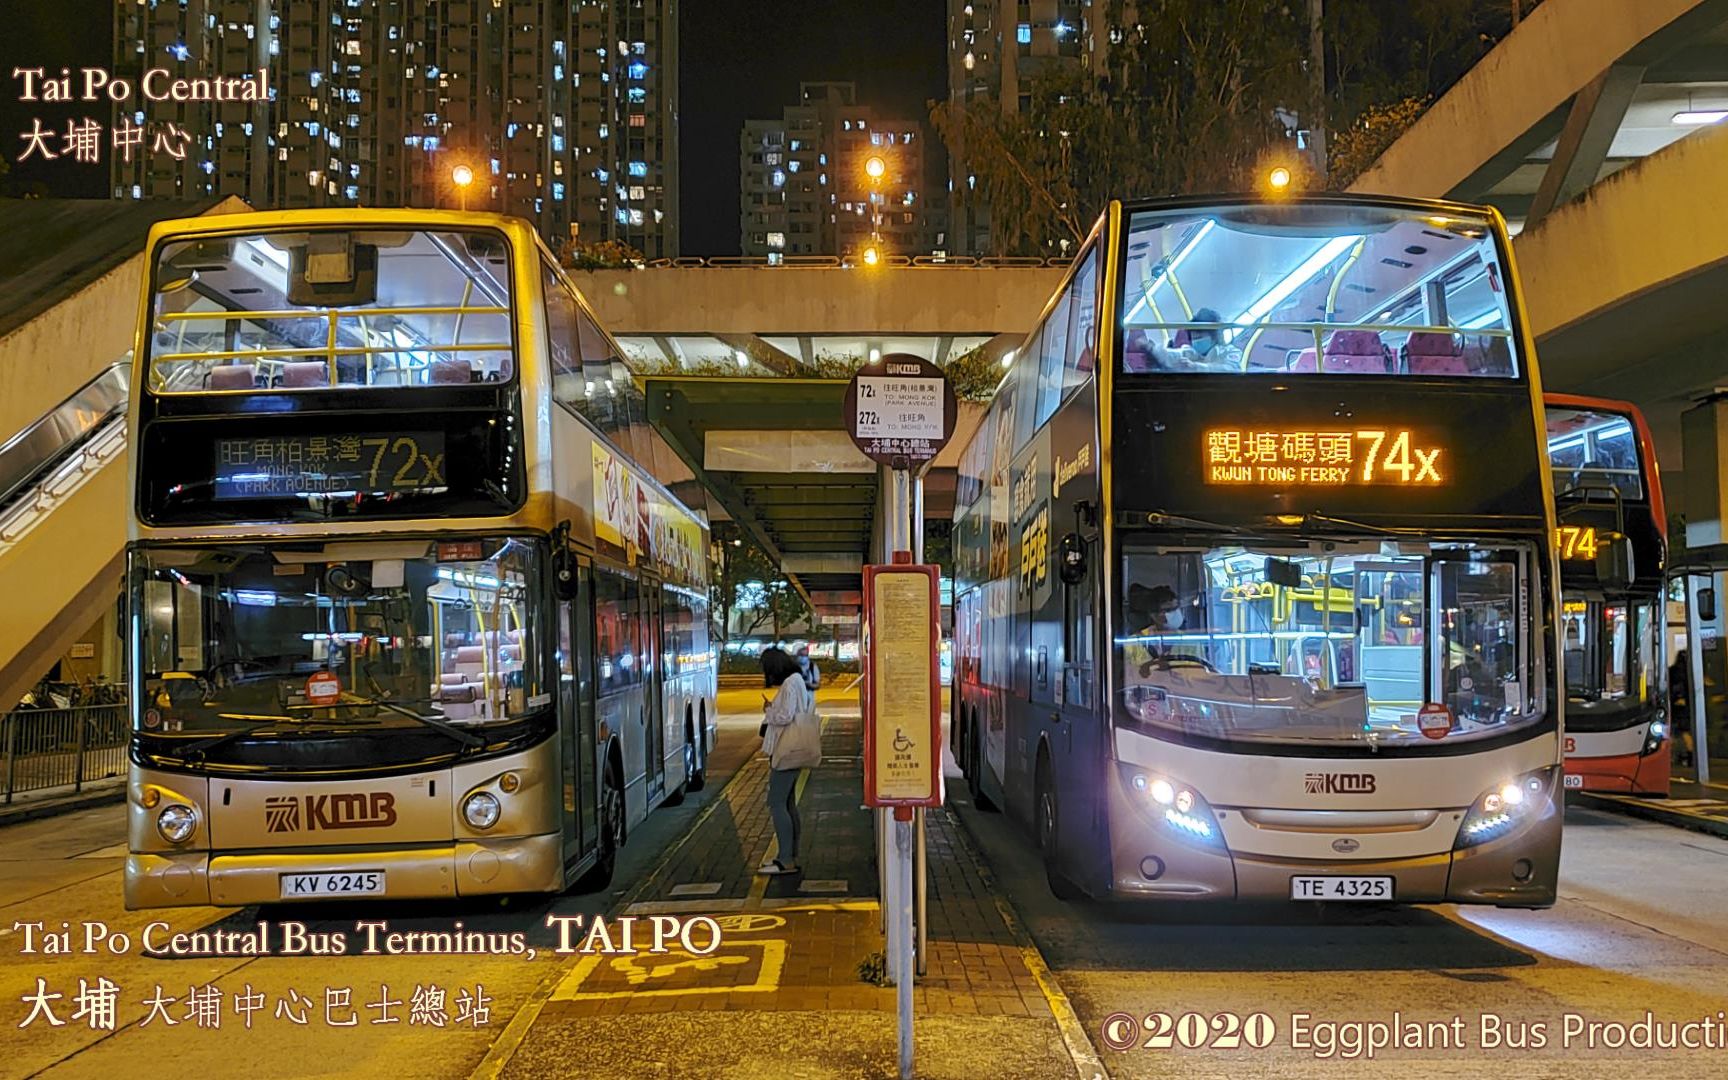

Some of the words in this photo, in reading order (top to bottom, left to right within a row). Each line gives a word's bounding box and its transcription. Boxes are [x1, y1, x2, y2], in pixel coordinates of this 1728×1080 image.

[896, 364, 921, 375] KMB
[1208, 431, 1353, 465] 觀塘碼頭
[256, 464, 294, 477] MONG
[1212, 467, 1252, 481] KWUN
[1259, 467, 1296, 481] TONG
[1300, 467, 1350, 482] FERRY
[1325, 773, 1376, 794] KMB
[305, 791, 397, 831] KMB
[294, 876, 319, 892] KV
[326, 874, 377, 891] 6245
[1299, 880, 1325, 896] TE
[1334, 880, 1385, 896] 4325
